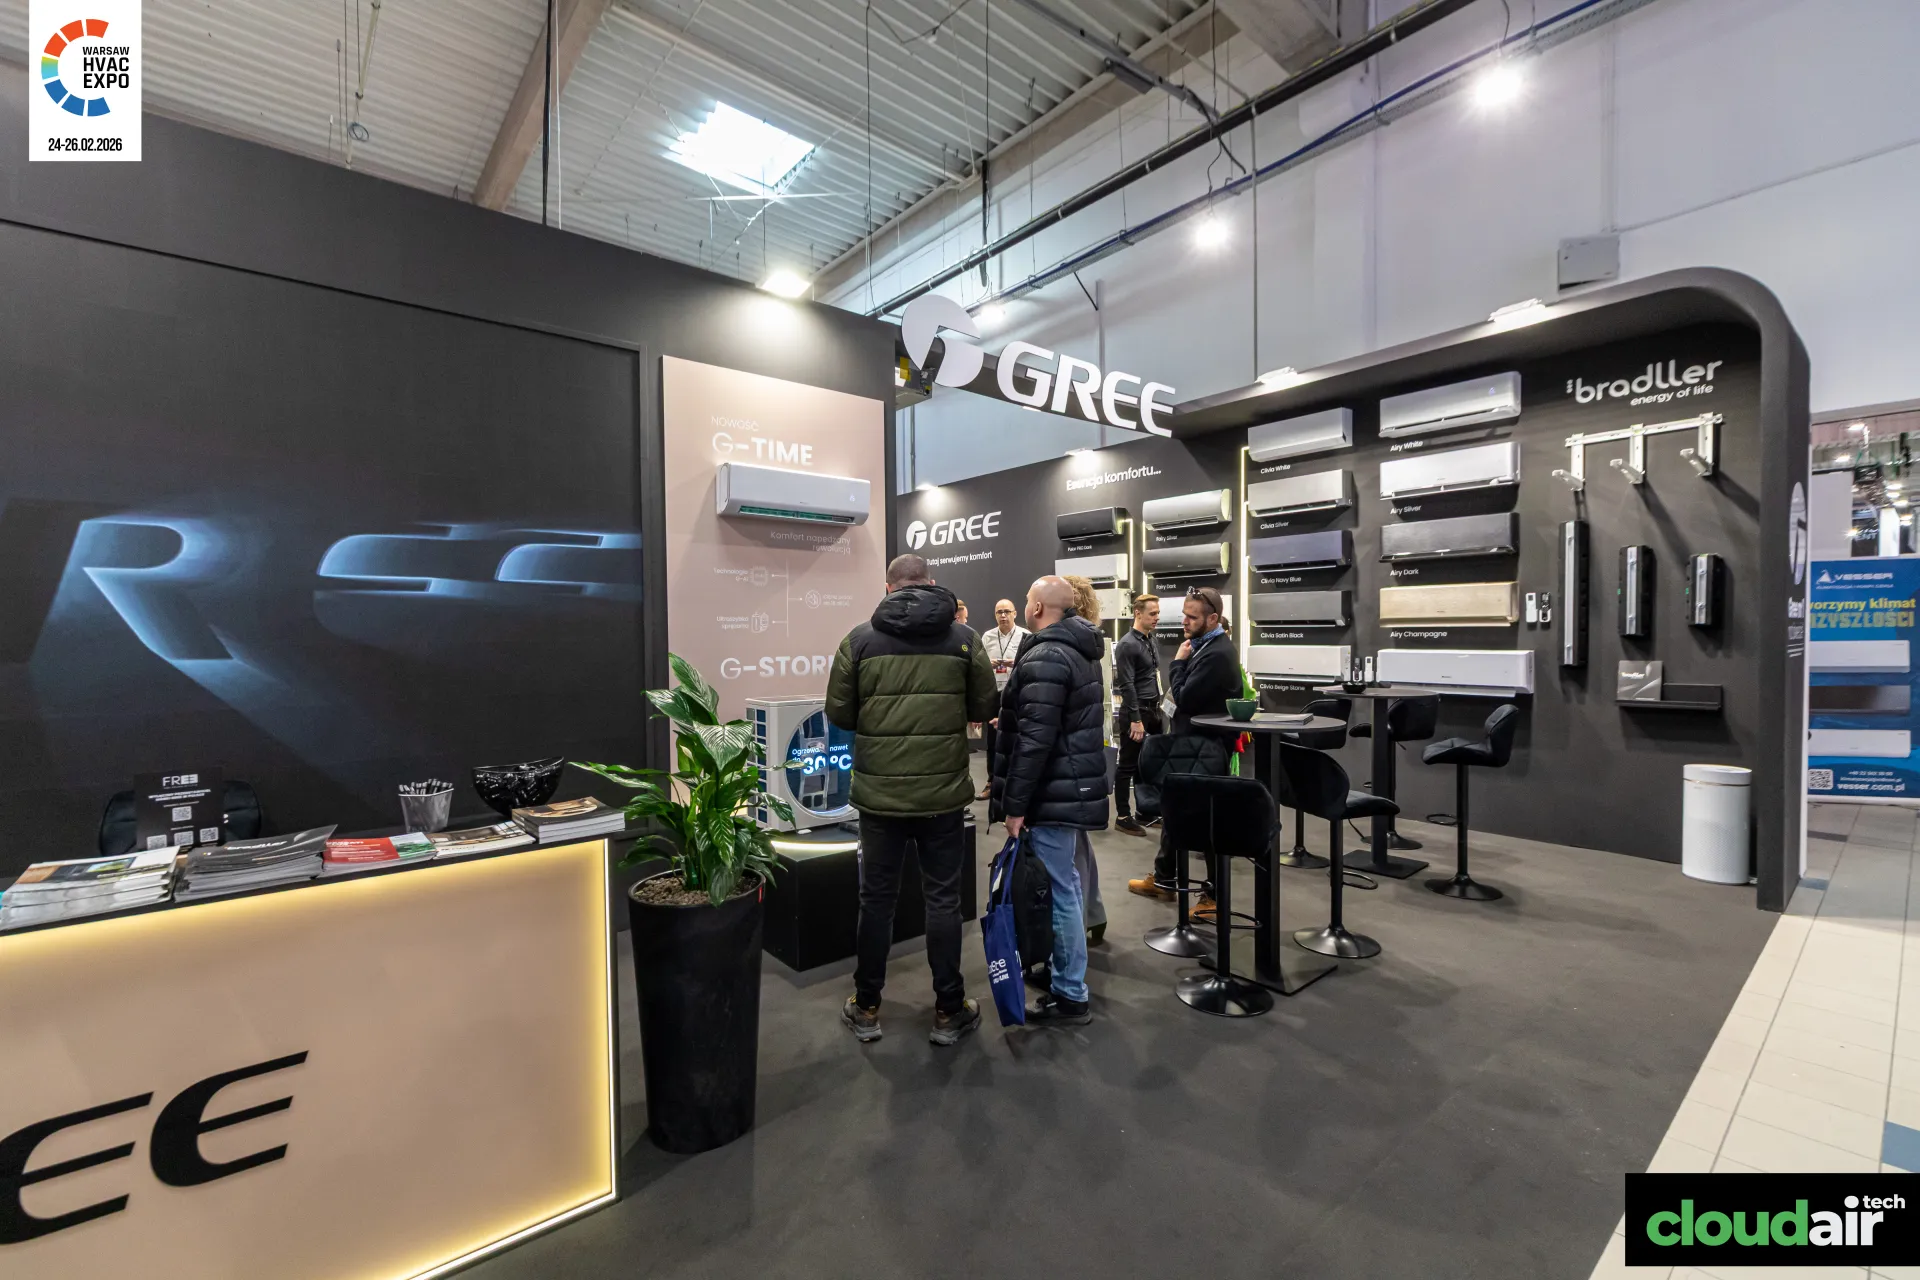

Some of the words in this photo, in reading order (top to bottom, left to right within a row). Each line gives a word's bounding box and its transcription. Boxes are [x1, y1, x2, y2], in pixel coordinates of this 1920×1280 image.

[1571, 359, 1723, 404] bradller
[997, 340, 1177, 438] GREE
[1630, 391, 1674, 406] energy
[1676, 388, 1691, 399] of
[1693, 383, 1714, 396] life
[711, 415, 760, 432] NOWOŚĆ
[712, 431, 814, 467] G-TIME
[1390, 443, 1403, 452] Airy
[1403, 440, 1423, 450] White
[1104, 465, 1162, 485] komfortu...
[1403, 504, 1422, 514] Silver
[930, 510, 1002, 546] GREE
[770, 531, 805, 543] Komfort
[969, 550, 993, 561] komfort
[1403, 568, 1420, 576] Dark
[1869, 598, 1917, 609] klimat
[1390, 630, 1403, 639] Airy
[1403, 630, 1448, 639] Champagne
[829, 744, 849, 752] nawet
[1837, 783, 1906, 792] vesser.com.pl
